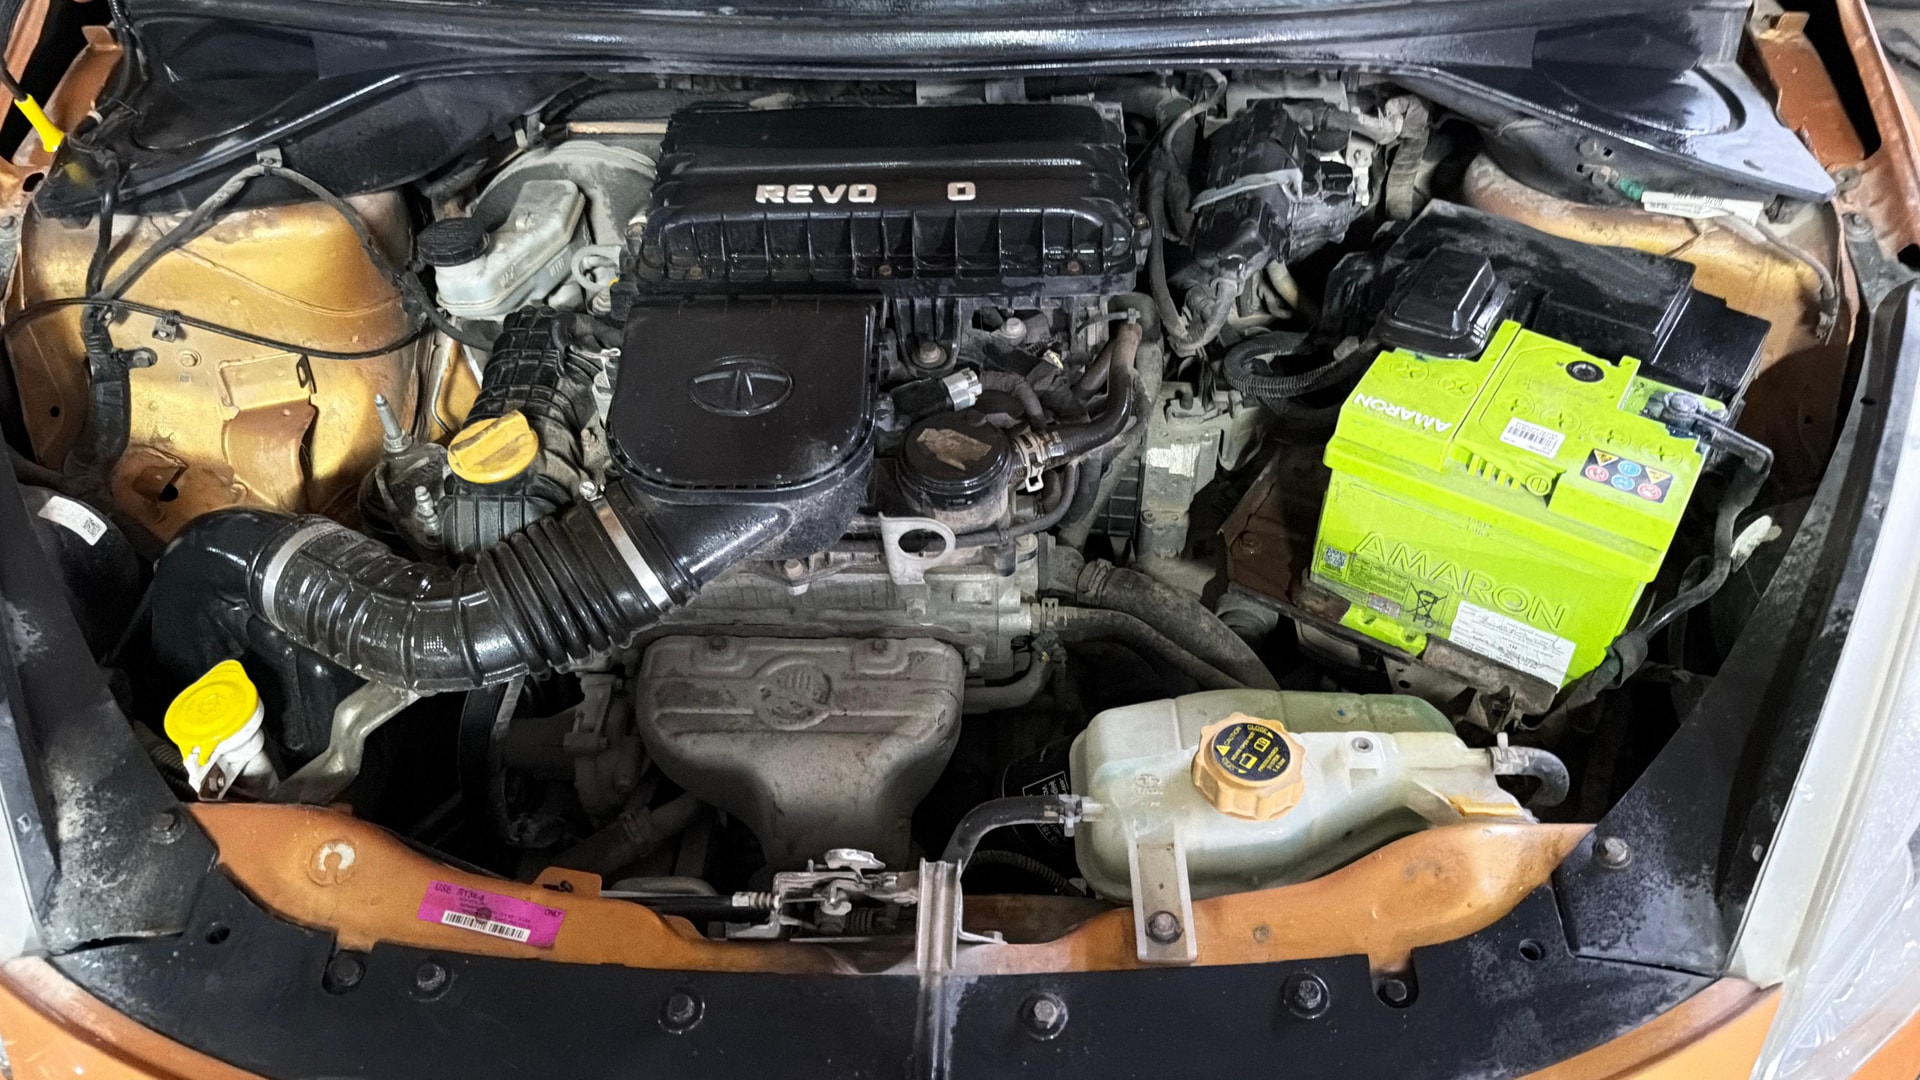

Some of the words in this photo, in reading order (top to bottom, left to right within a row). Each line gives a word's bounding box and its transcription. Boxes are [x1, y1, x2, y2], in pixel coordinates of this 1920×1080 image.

[755, 184, 877, 203] REVO
[1353, 393, 1452, 432] AMARON
[1354, 531, 1570, 632] AMARON
